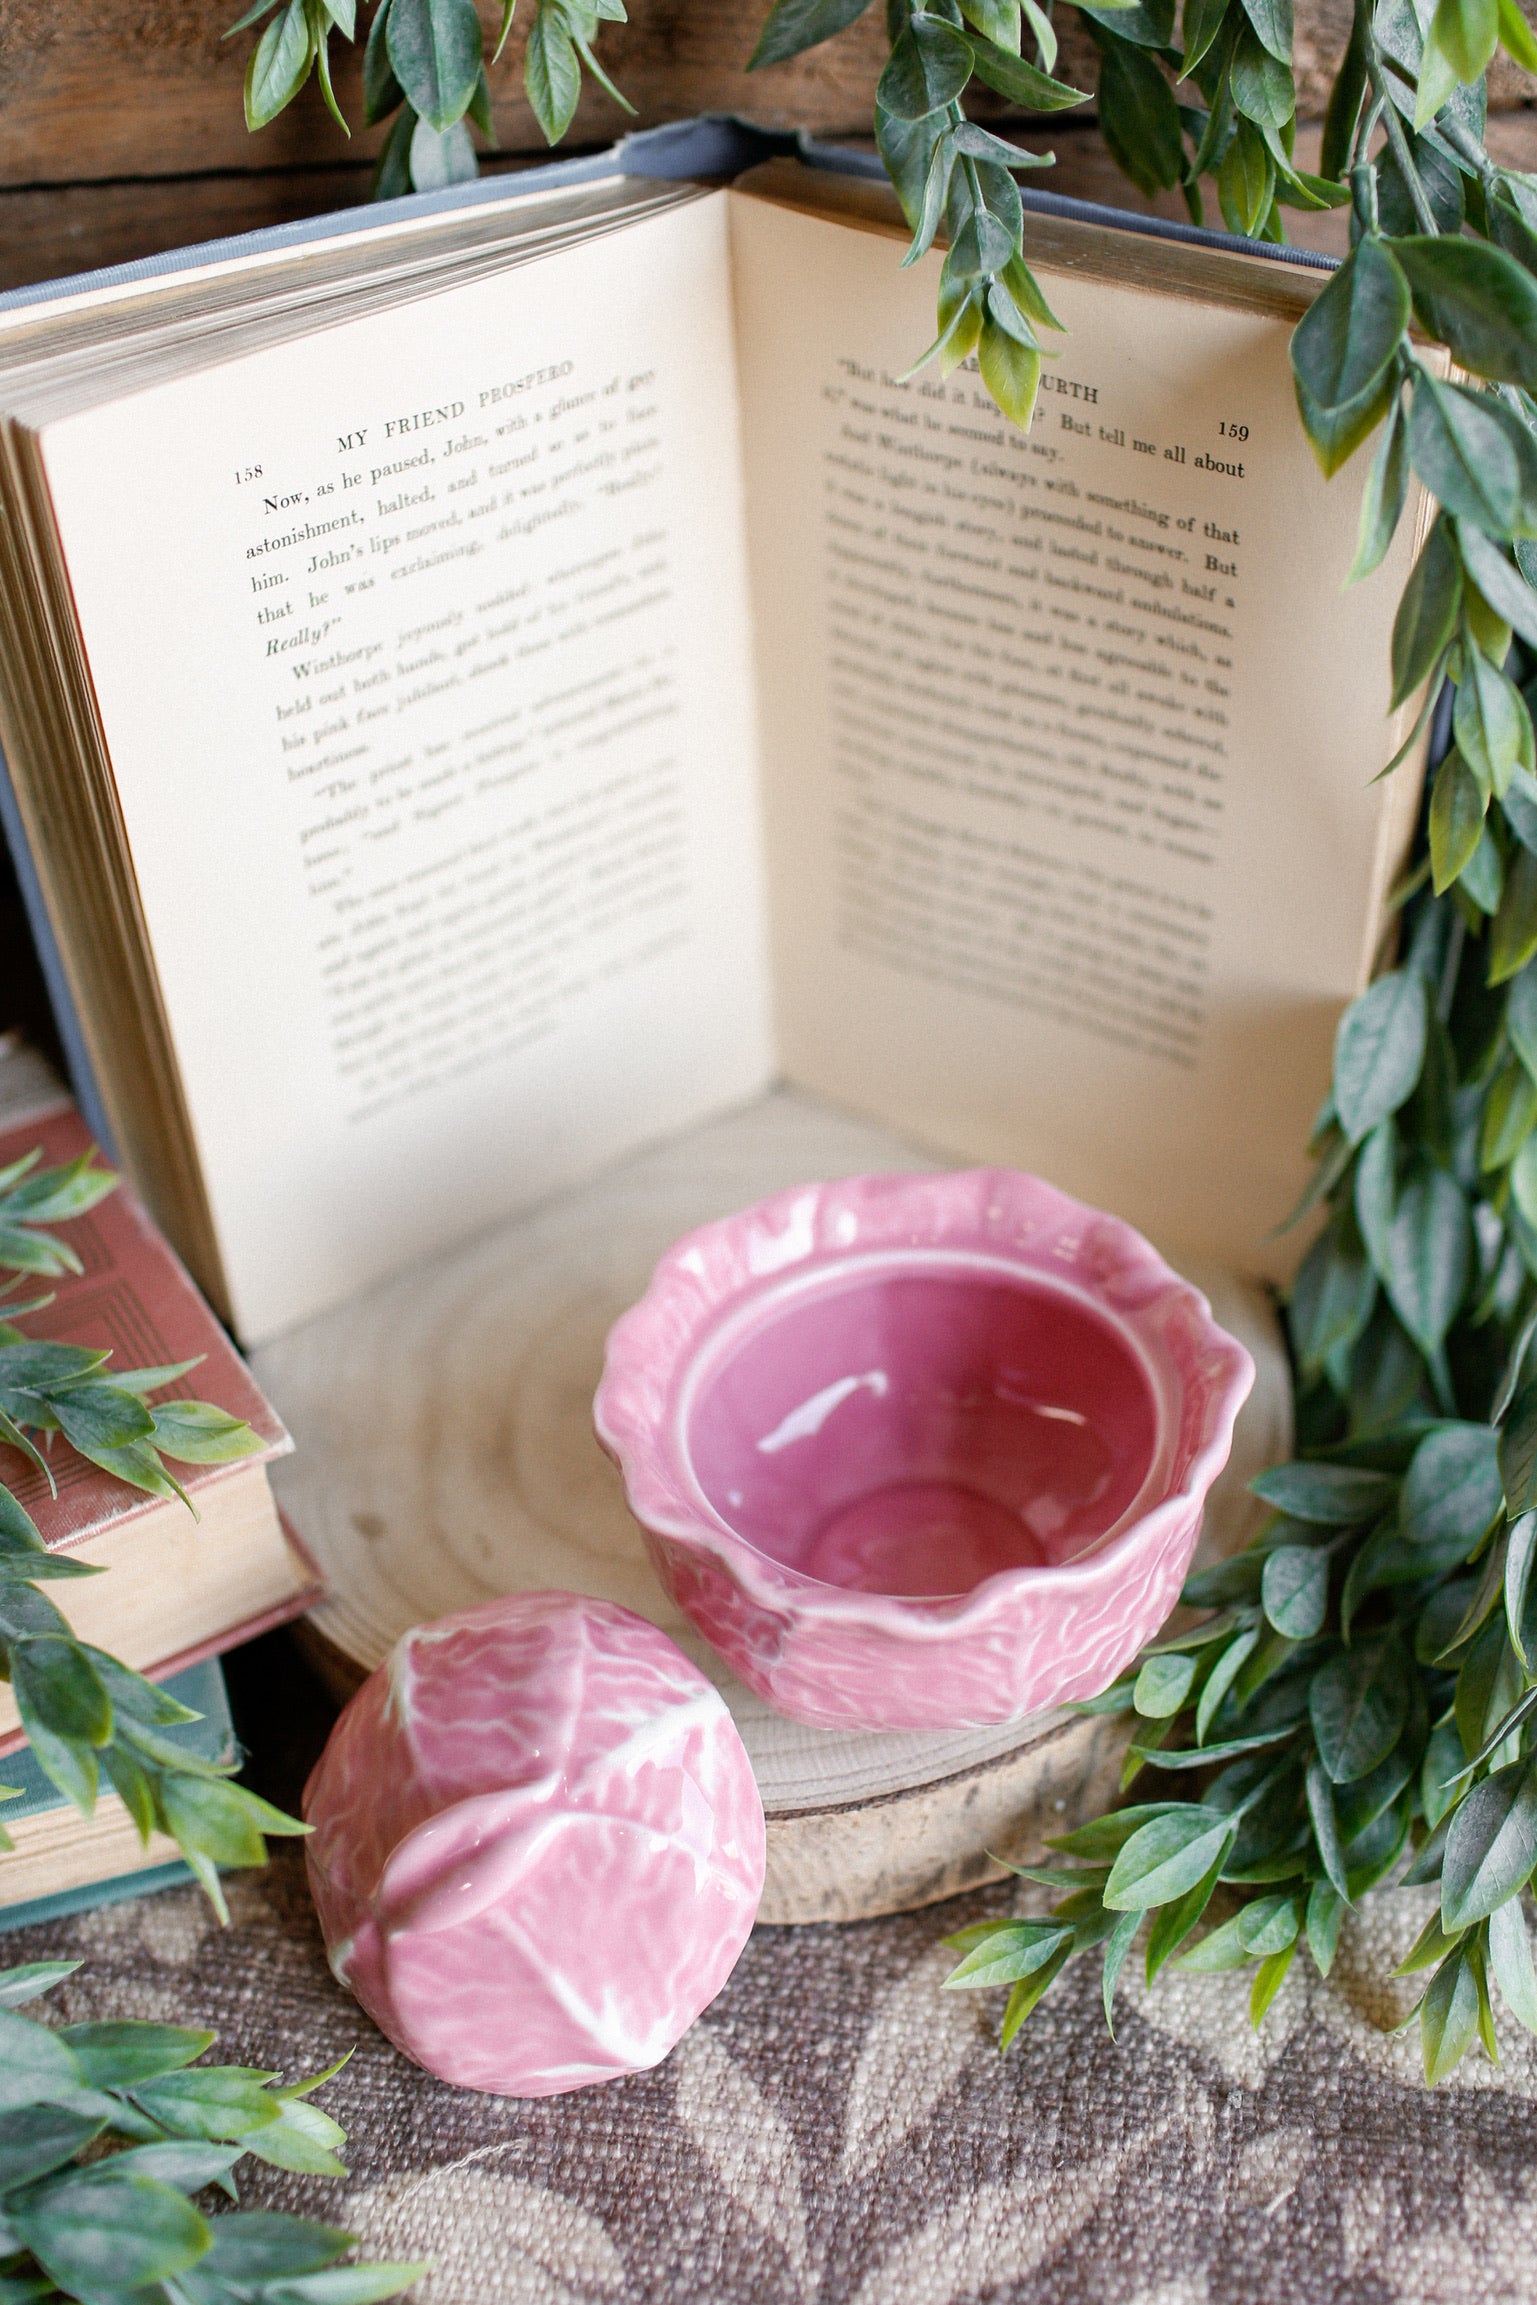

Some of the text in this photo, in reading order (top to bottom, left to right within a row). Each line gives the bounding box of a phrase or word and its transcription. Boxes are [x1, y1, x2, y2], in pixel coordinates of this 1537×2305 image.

[337, 360, 573, 452] MY FRIEND PROSPERO
[1038, 373, 1098, 404] URTH
[917, 381, 946, 399] did
[952, 387, 965, 403] it
[1061, 413, 1092, 437] But
[1099, 426, 1125, 447] tell
[1133, 437, 1156, 455] me
[1164, 446, 1186, 464] all
[1194, 453, 1245, 478] about
[1009, 434, 1027, 450] to
[1031, 442, 1065, 463] say.
[1218, 421, 1249, 442] 159
[234, 464, 263, 485] 158
[263, 490, 309, 514] Now,
[317, 480, 334, 496] as
[342, 472, 362, 489] he
[370, 448, 435, 485] paused,
[443, 434, 488, 457] John,
[496, 415, 527, 436] with
[534, 412, 541, 423] a
[246, 510, 364, 559] astonishment,
[378, 485, 435, 516] halted,
[447, 469, 477, 493] and
[1045, 475, 1080, 497] with
[1087, 491, 1170, 529] something
[1176, 516, 1196, 532] of
[1204, 522, 1240, 545] that
[251, 571, 289, 592] him.
[307, 543, 364, 573] John’s
[370, 535, 401, 554] lips
[1107, 525, 1124, 541] to
[1128, 535, 1189, 563] answer.
[1205, 553, 1238, 577] But
[257, 600, 294, 624] that
[309, 591, 328, 607] he
[345, 574, 375, 594] was
[1182, 577, 1216, 602] half
[1225, 597, 1235, 608] a
[276, 698, 312, 721] held
[319, 684, 346, 706] out
[353, 669, 391, 694] both
[281, 731, 306, 753] his
[313, 715, 349, 745] pink
